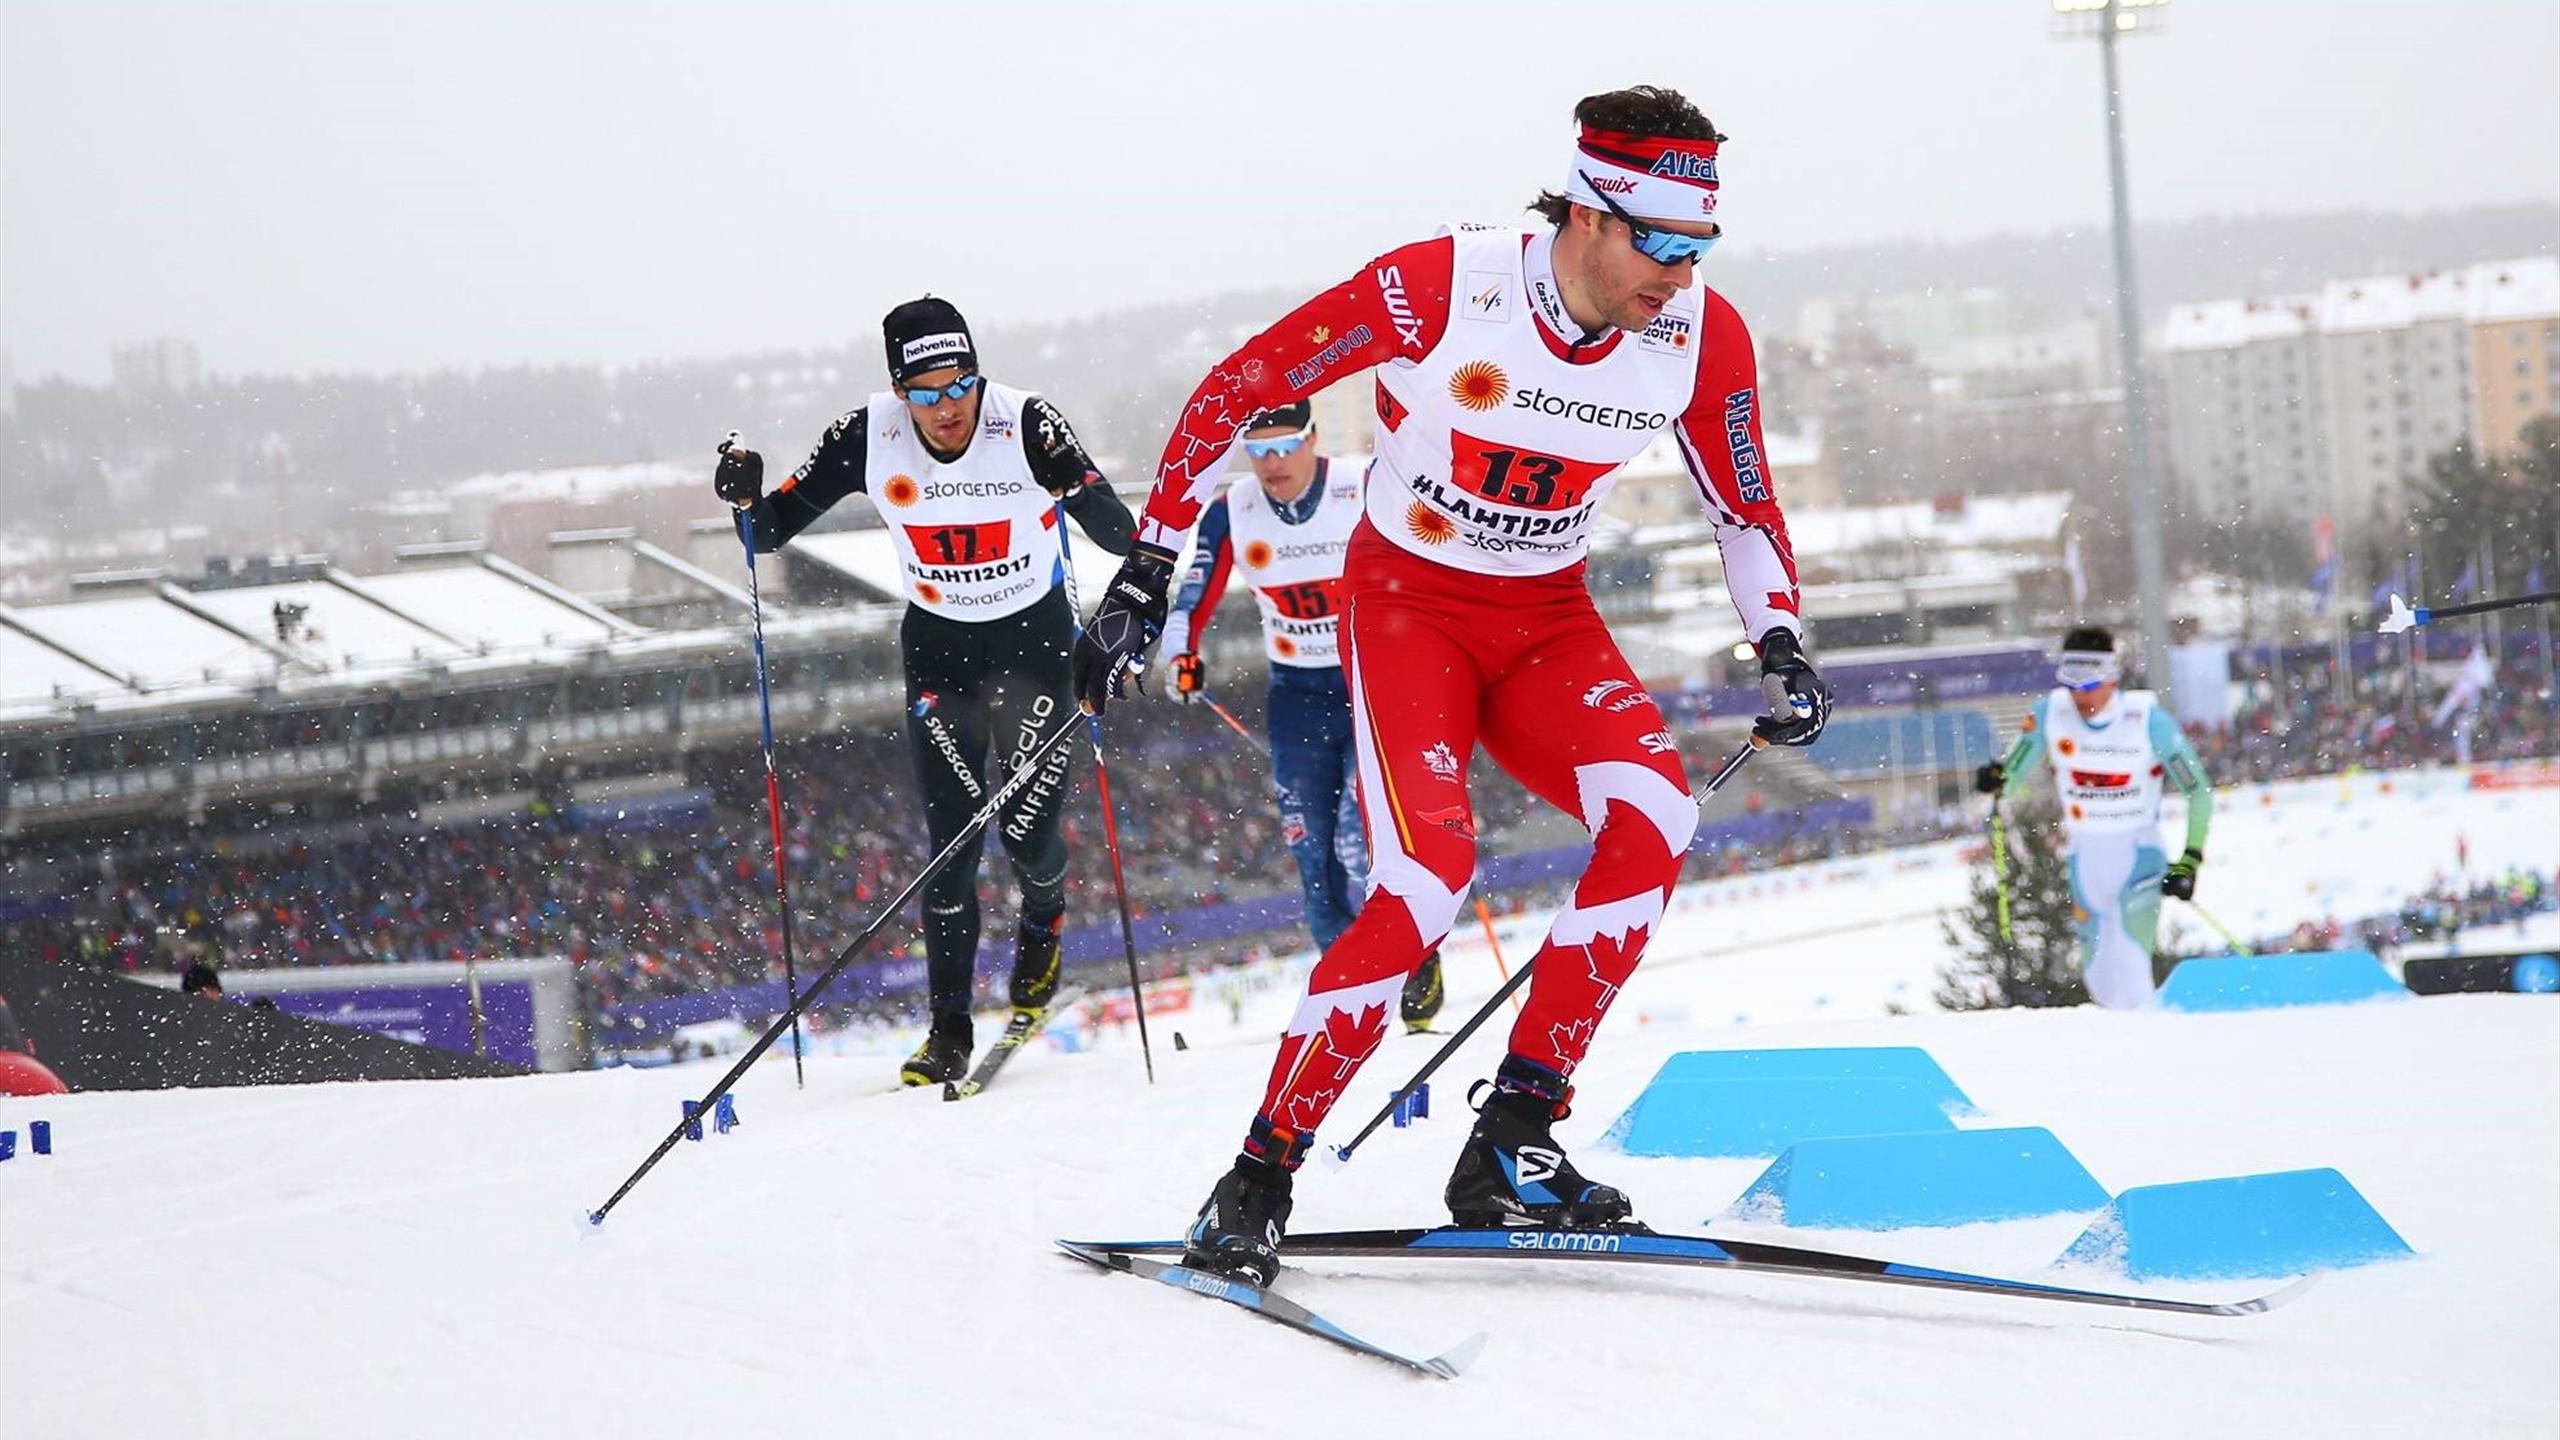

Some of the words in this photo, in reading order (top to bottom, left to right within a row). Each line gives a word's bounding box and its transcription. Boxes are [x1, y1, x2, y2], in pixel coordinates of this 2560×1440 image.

[1649, 317, 1690, 334] AHTI
[906, 338, 957, 358] helvetia
[1285, 325, 1374, 390] HAYWOOD
[1512, 387, 1667, 431] storaenso
[924, 481, 1022, 500] storaenso
[1479, 449, 1566, 507] 13
[931, 528, 977, 564] 17
[907, 553, 1031, 583] #LAHTI2017
[945, 577, 1036, 607] storaenso
[1280, 582, 1328, 618] 15
[1009, 695, 1055, 772] odlo
[925, 716, 982, 798] swisscom
[1507, 1231, 1620, 1252] salomon
